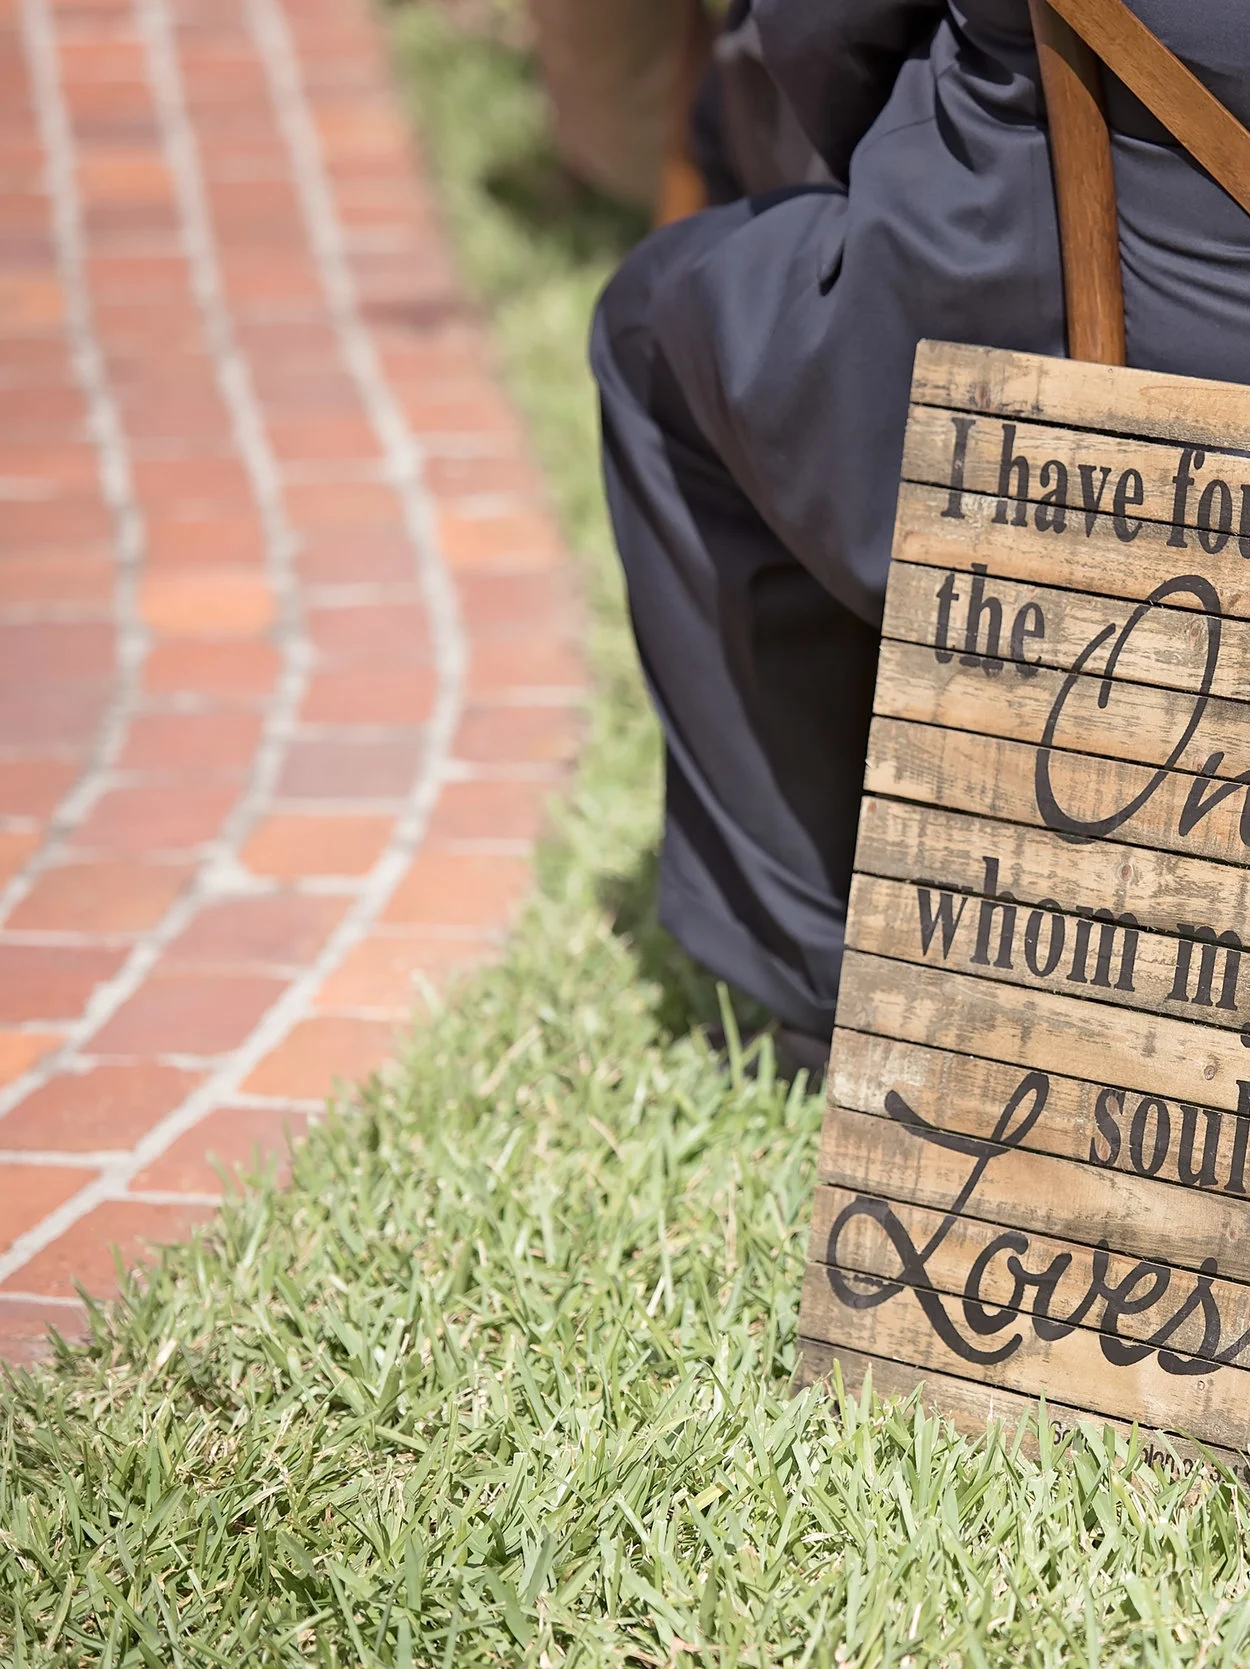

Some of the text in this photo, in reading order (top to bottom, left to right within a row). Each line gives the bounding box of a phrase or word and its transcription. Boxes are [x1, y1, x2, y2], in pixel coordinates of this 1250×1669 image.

[940, 417, 976, 519] I
[990, 424, 1145, 543] have
[933, 563, 1046, 677] the
[915, 856, 1139, 993] whom
